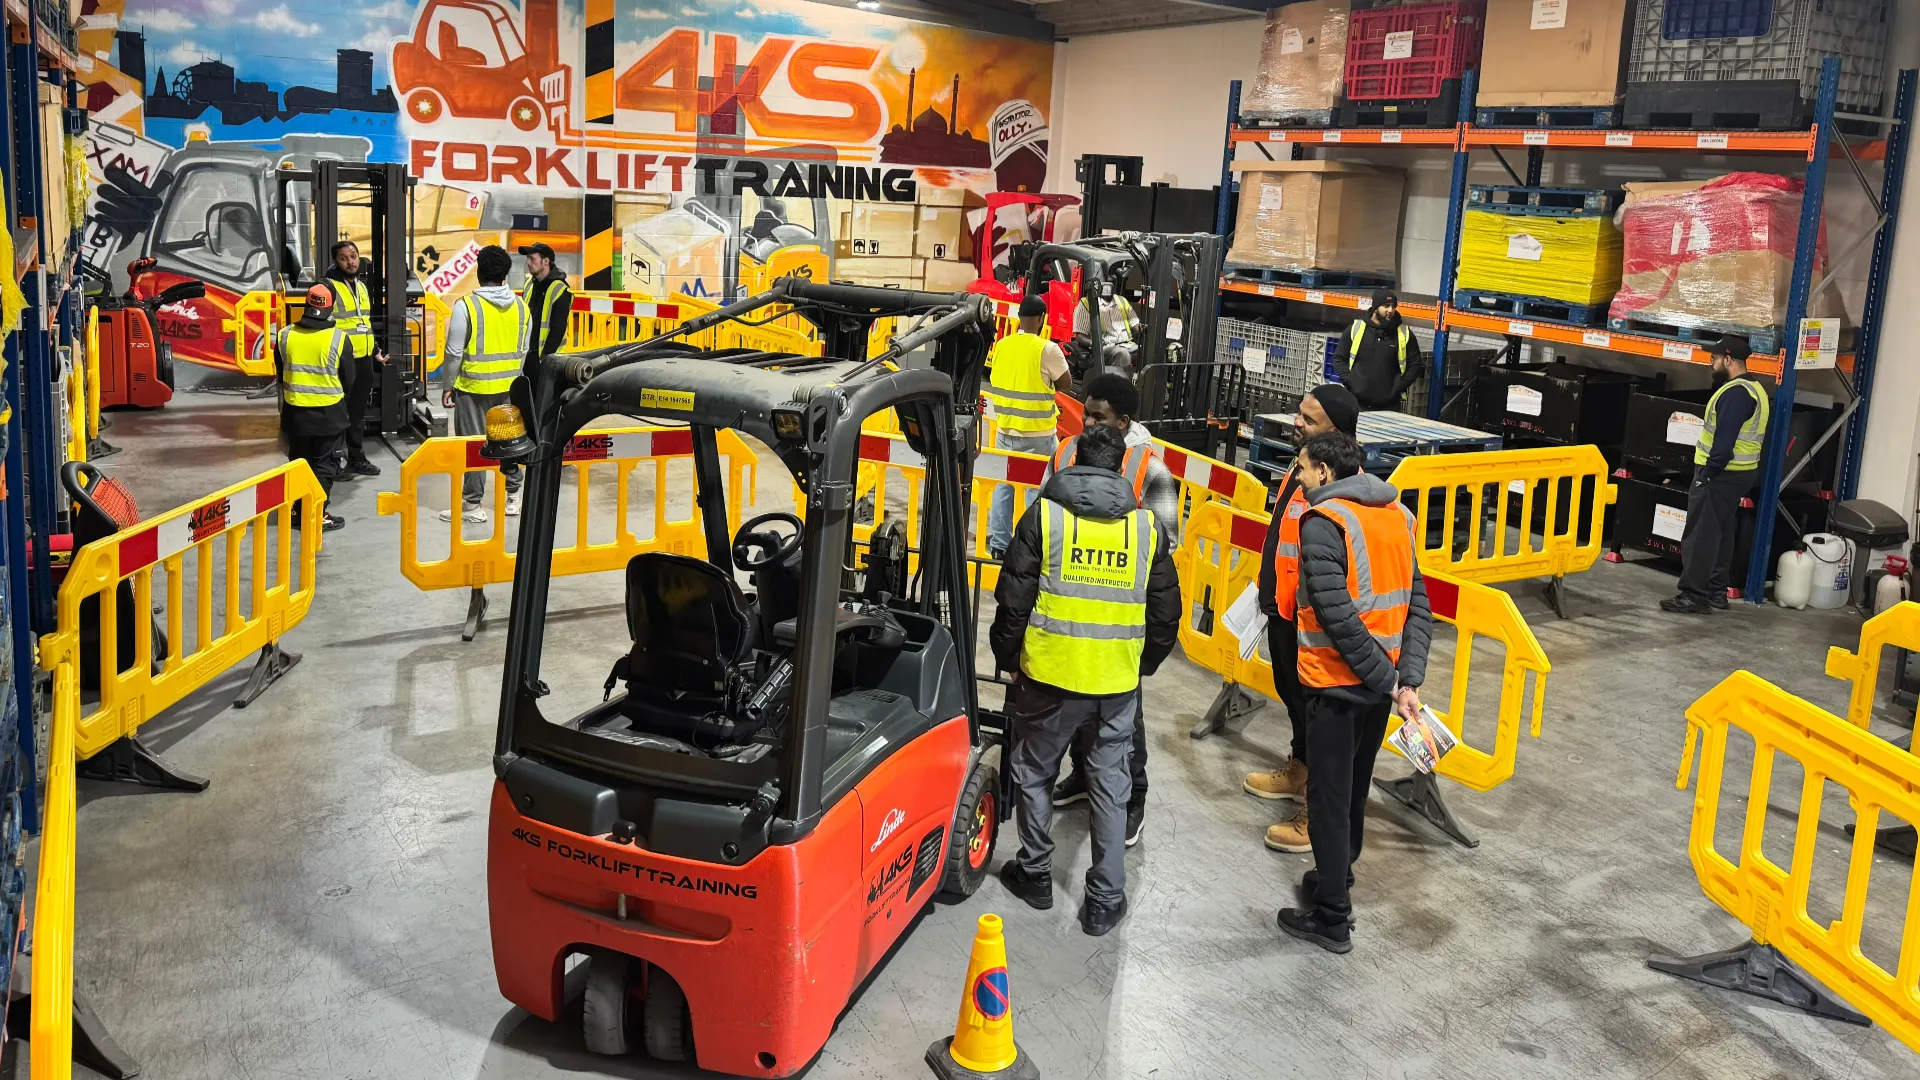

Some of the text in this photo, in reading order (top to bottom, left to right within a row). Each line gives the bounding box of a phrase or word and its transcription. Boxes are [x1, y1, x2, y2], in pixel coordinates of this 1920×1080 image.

[616, 30, 881, 143] 4KS
[425, 244, 480, 293] RAGILE
[576, 437, 614, 449] 4KS
[204, 499, 231, 521] 4KS
[1071, 548, 1128, 568] RTITB
[511, 827, 541, 848] 4KS
[870, 808, 906, 853] Linde
[884, 842, 914, 886] 4KS
